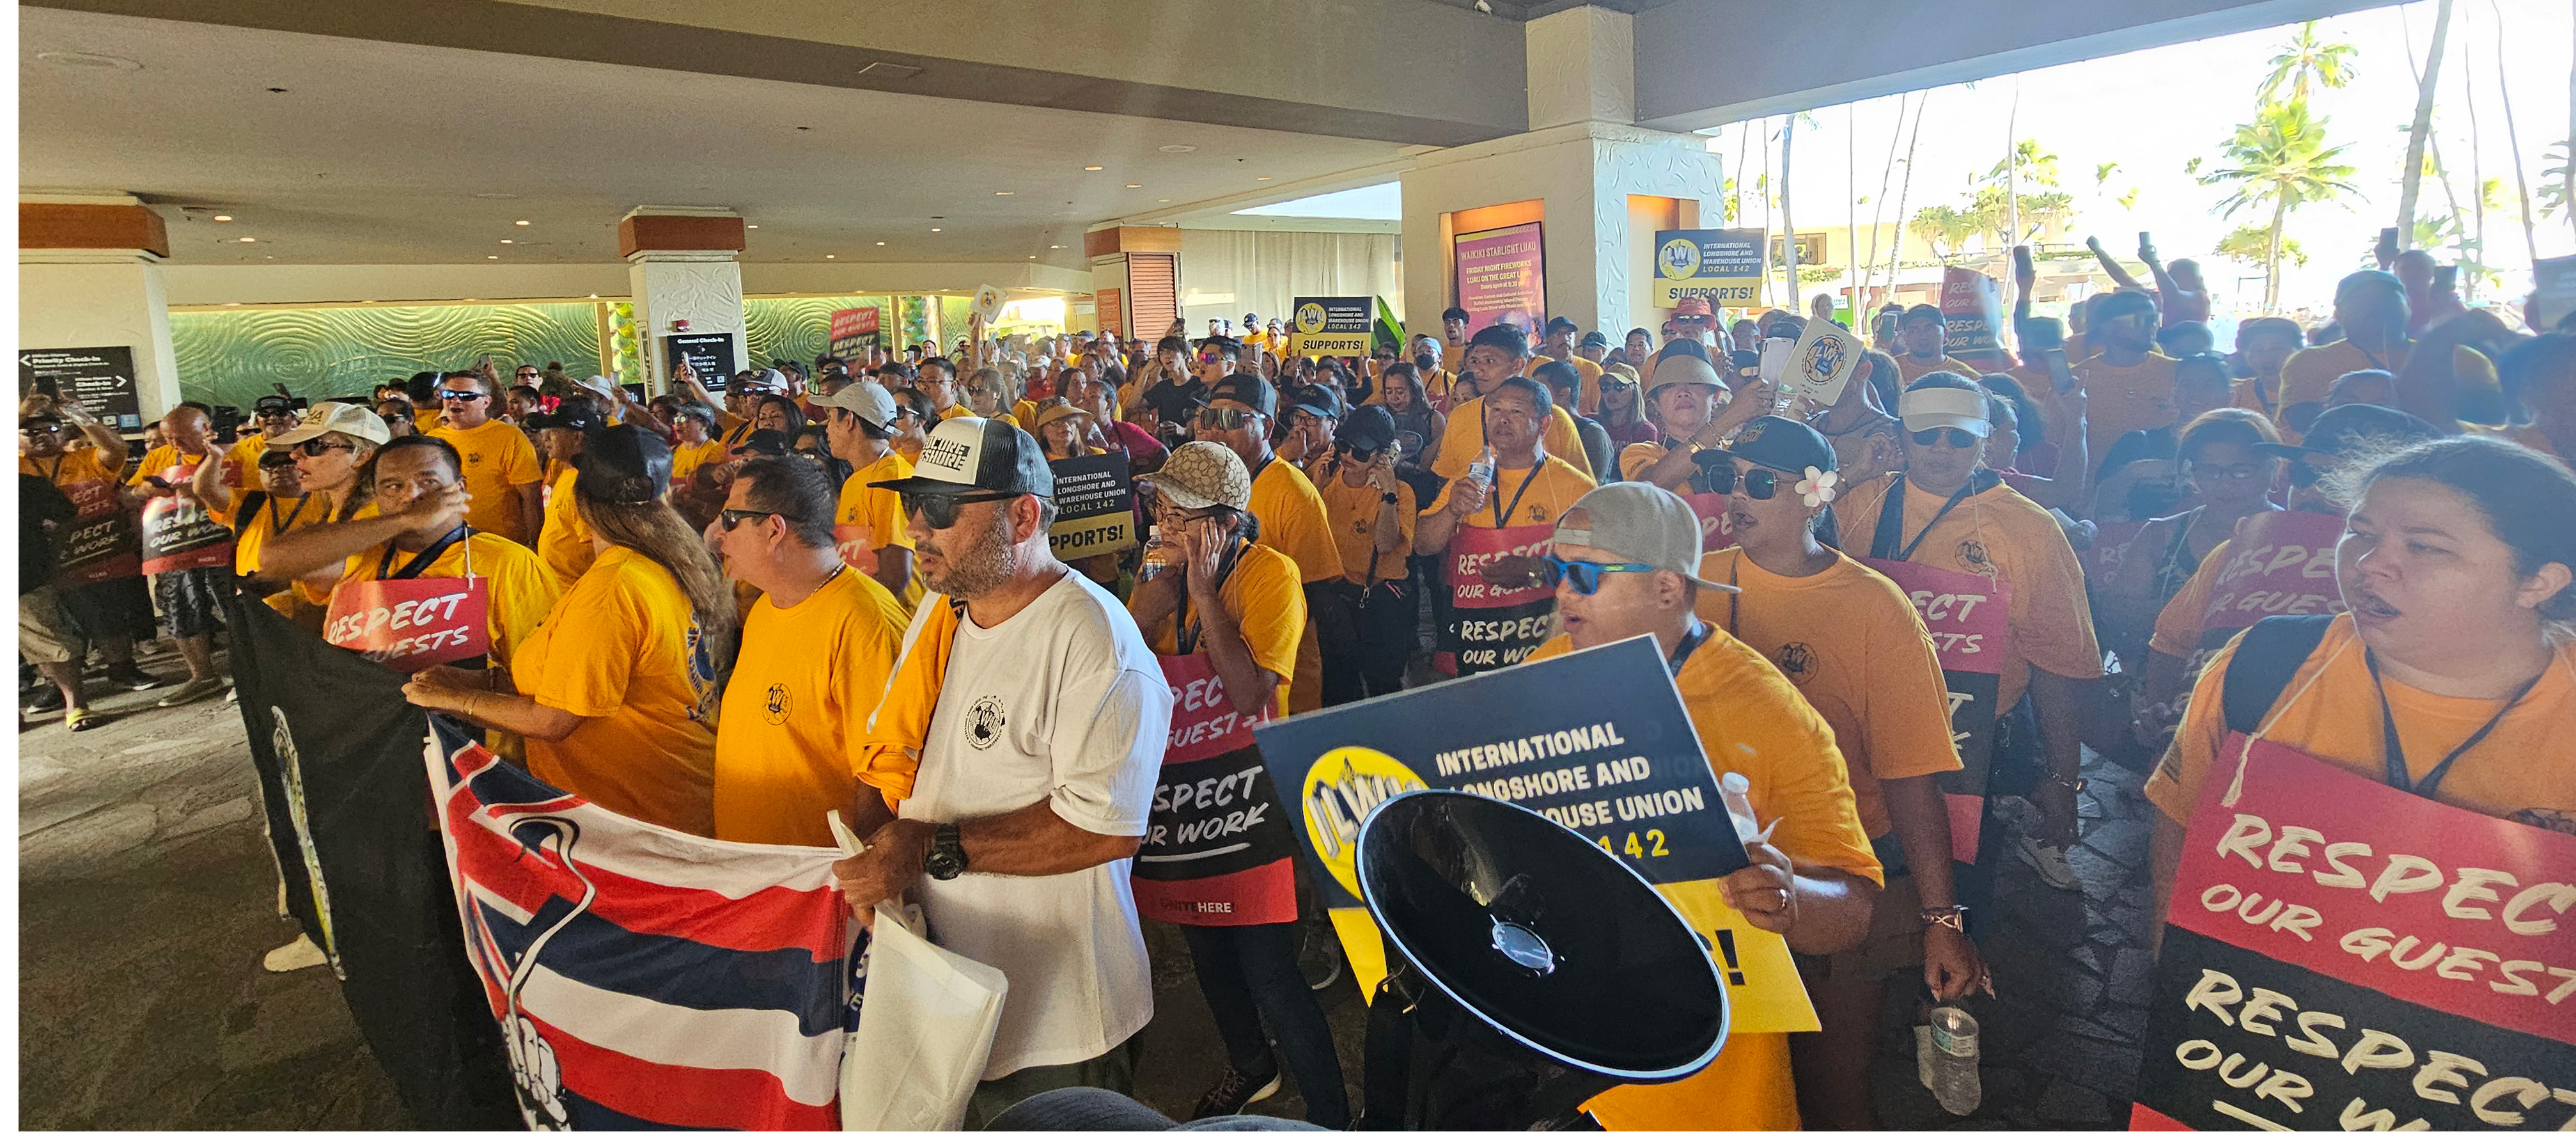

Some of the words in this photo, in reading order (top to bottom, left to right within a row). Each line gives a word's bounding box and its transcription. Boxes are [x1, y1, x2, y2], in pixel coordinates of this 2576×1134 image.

[1461, 249, 1485, 261] WAIKIKI
[1486, 243, 1520, 257] STARLIGHT
[1520, 241, 1536, 253] LUAU
[1485, 264, 1501, 272] NIGHT
[1501, 260, 1532, 270] FIREWORKS
[1489, 273, 1499, 281] THE
[1499, 271, 1517, 280] GREAT
[1302, 340, 1364, 350] SUPPORTS!
[1056, 471, 1112, 485] INTERNATIONAL
[1058, 482, 1100, 495] LONGSHORE
[1100, 480, 1116, 488] AND
[1059, 492, 1104, 505] WAREHOUSE
[1104, 488, 1126, 498] UNION
[1061, 503, 1093, 515] LOCAL
[1096, 499, 1115, 509] 142
[69, 519, 116, 545] PECT
[1050, 524, 1123, 550] PPORTS!
[1457, 584, 1485, 599] OUR
[327, 592, 468, 645] RESPECT
[1462, 649, 1497, 665] OUR
[1435, 721, 1625, 777] INTERNATIONAL
[1596, 755, 1650, 787] AND
[1153, 764, 1264, 813] SPECT
[1616, 785, 1705, 822] UNION
[1141, 824, 1167, 846] UR
[1176, 801, 1269, 844] WORK
[2216, 813, 2576, 936] RESPEC
[2201, 883, 2323, 942] OUR
[2339, 927, 2576, 1005] GUEST
[2176, 1039, 2314, 1114] OUR
